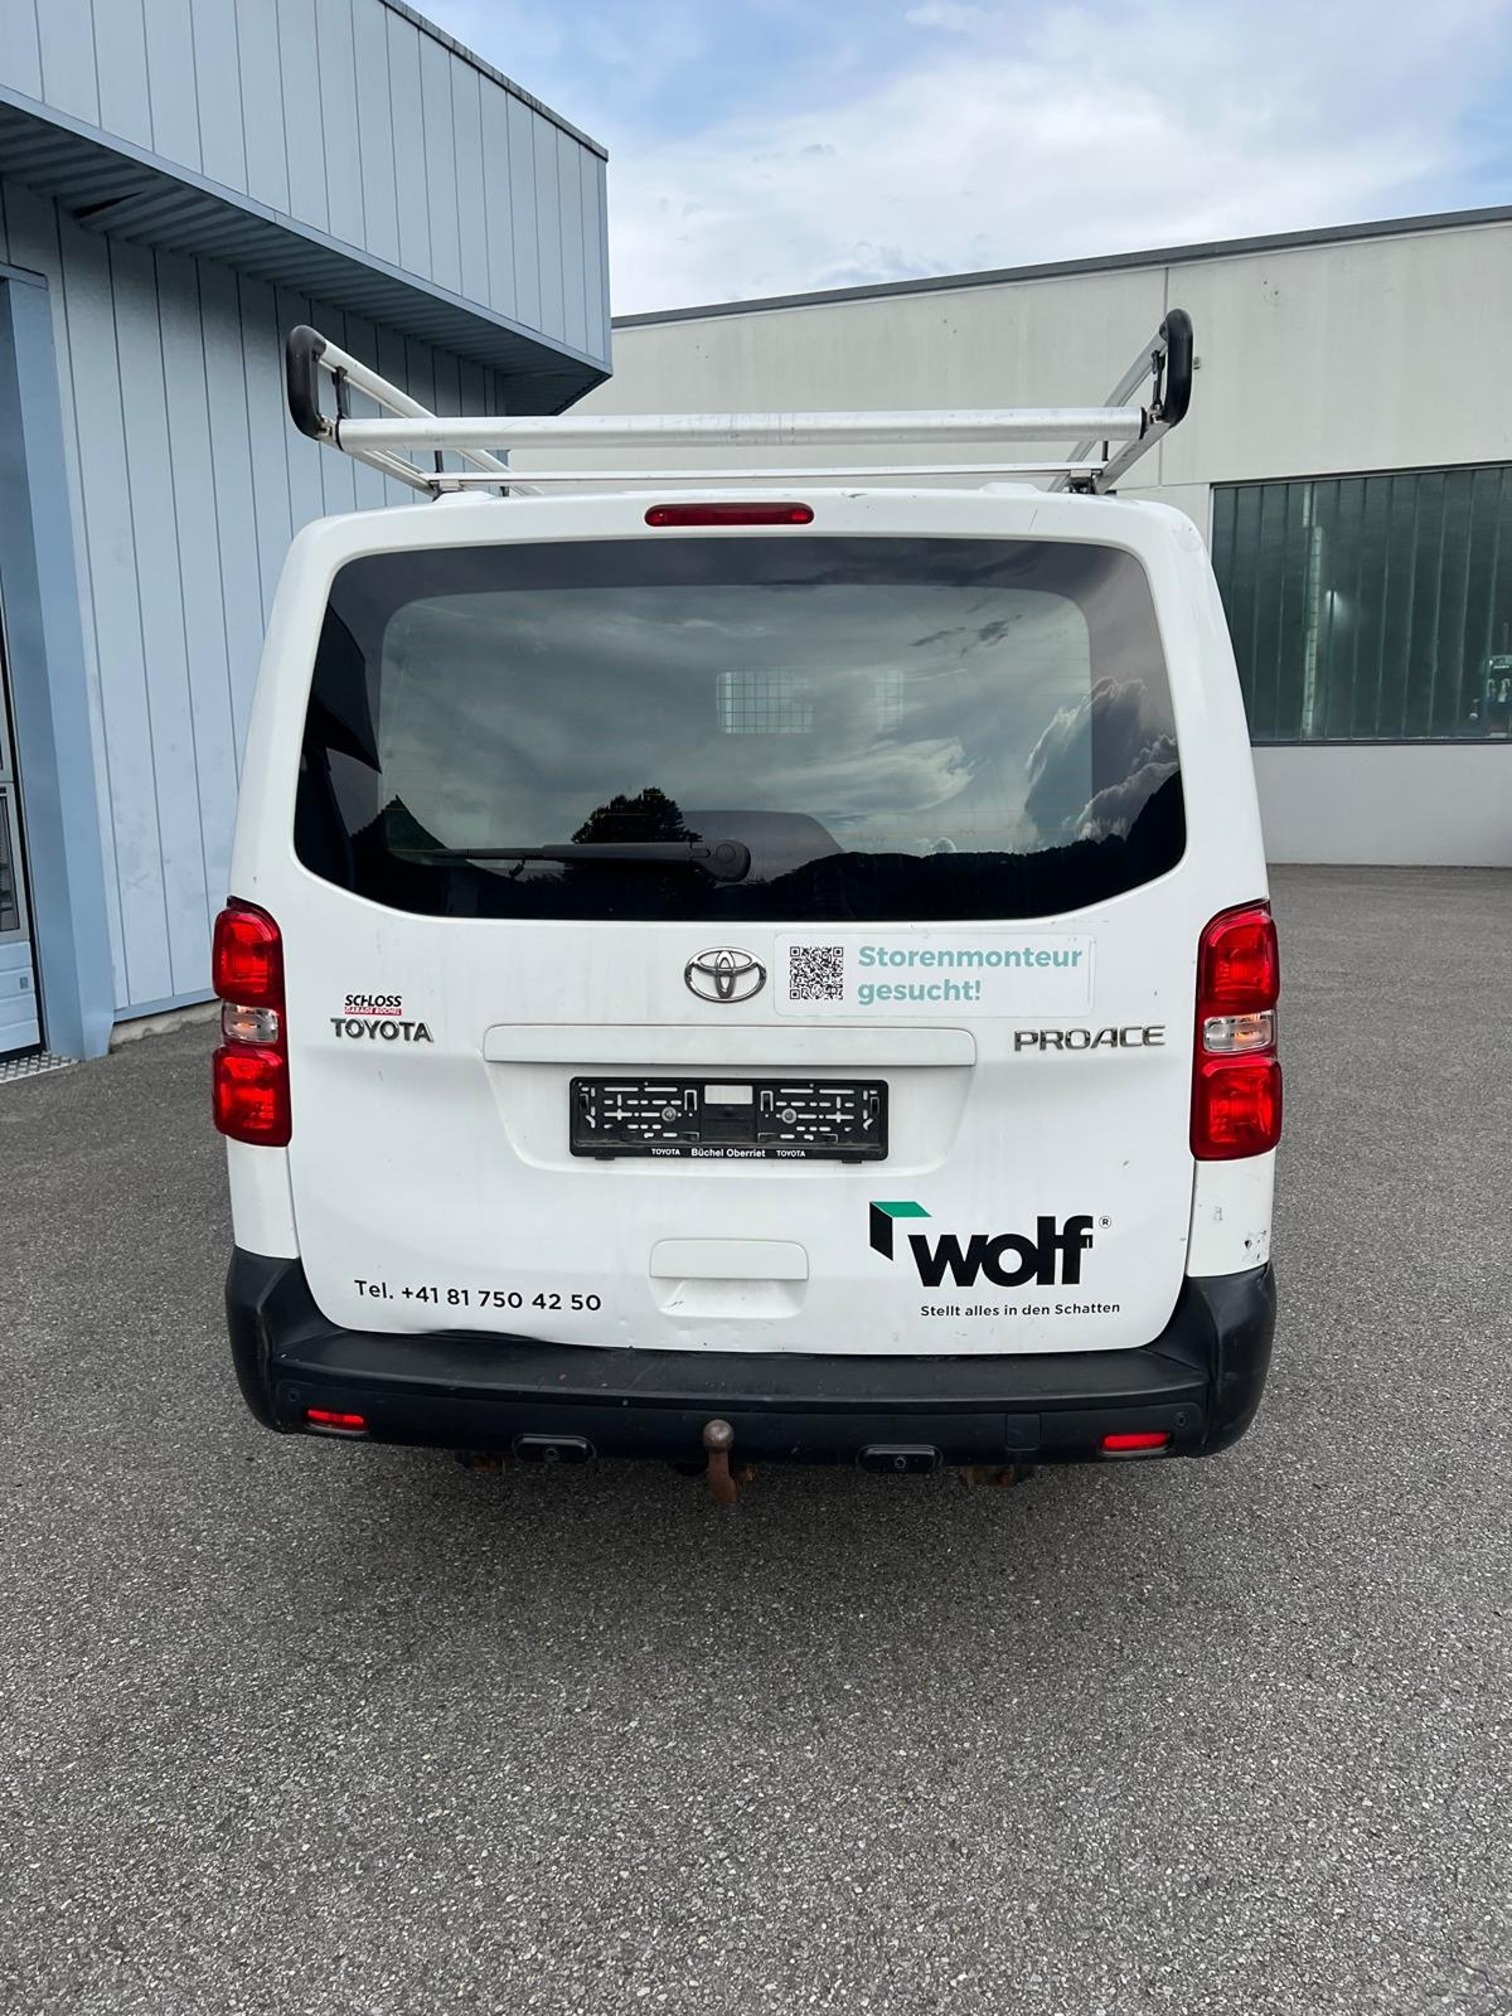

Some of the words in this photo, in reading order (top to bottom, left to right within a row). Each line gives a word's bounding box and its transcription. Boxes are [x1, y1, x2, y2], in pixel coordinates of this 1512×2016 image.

[858, 945, 1083, 968] Storenmonteur
[344, 994, 403, 1007] SCHLOSS
[857, 978, 981, 1006] gesucht!
[330, 1017, 434, 1043] TOYOTA
[1013, 1025, 1166, 1052] PROACE
[651, 1148, 681, 1156] TOYOTA
[691, 1148, 724, 1157] Büchel
[726, 1148, 766, 1158] Oberriet
[776, 1149, 806, 1158] TOYOTA
[907, 1214, 1094, 1288] wolf
[354, 1279, 394, 1300] Tel.
[401, 1286, 439, 1304] +41
[447, 1288, 470, 1306] 81
[478, 1290, 523, 1309] 750
[531, 1293, 562, 1310] 42
[571, 1294, 602, 1311] 50
[920, 1305, 961, 1317] Stellt
[964, 1305, 1000, 1316] alles
[1004, 1304, 1018, 1316] in
[1021, 1304, 1050, 1316] den
[1054, 1303, 1120, 1315] Schatten
